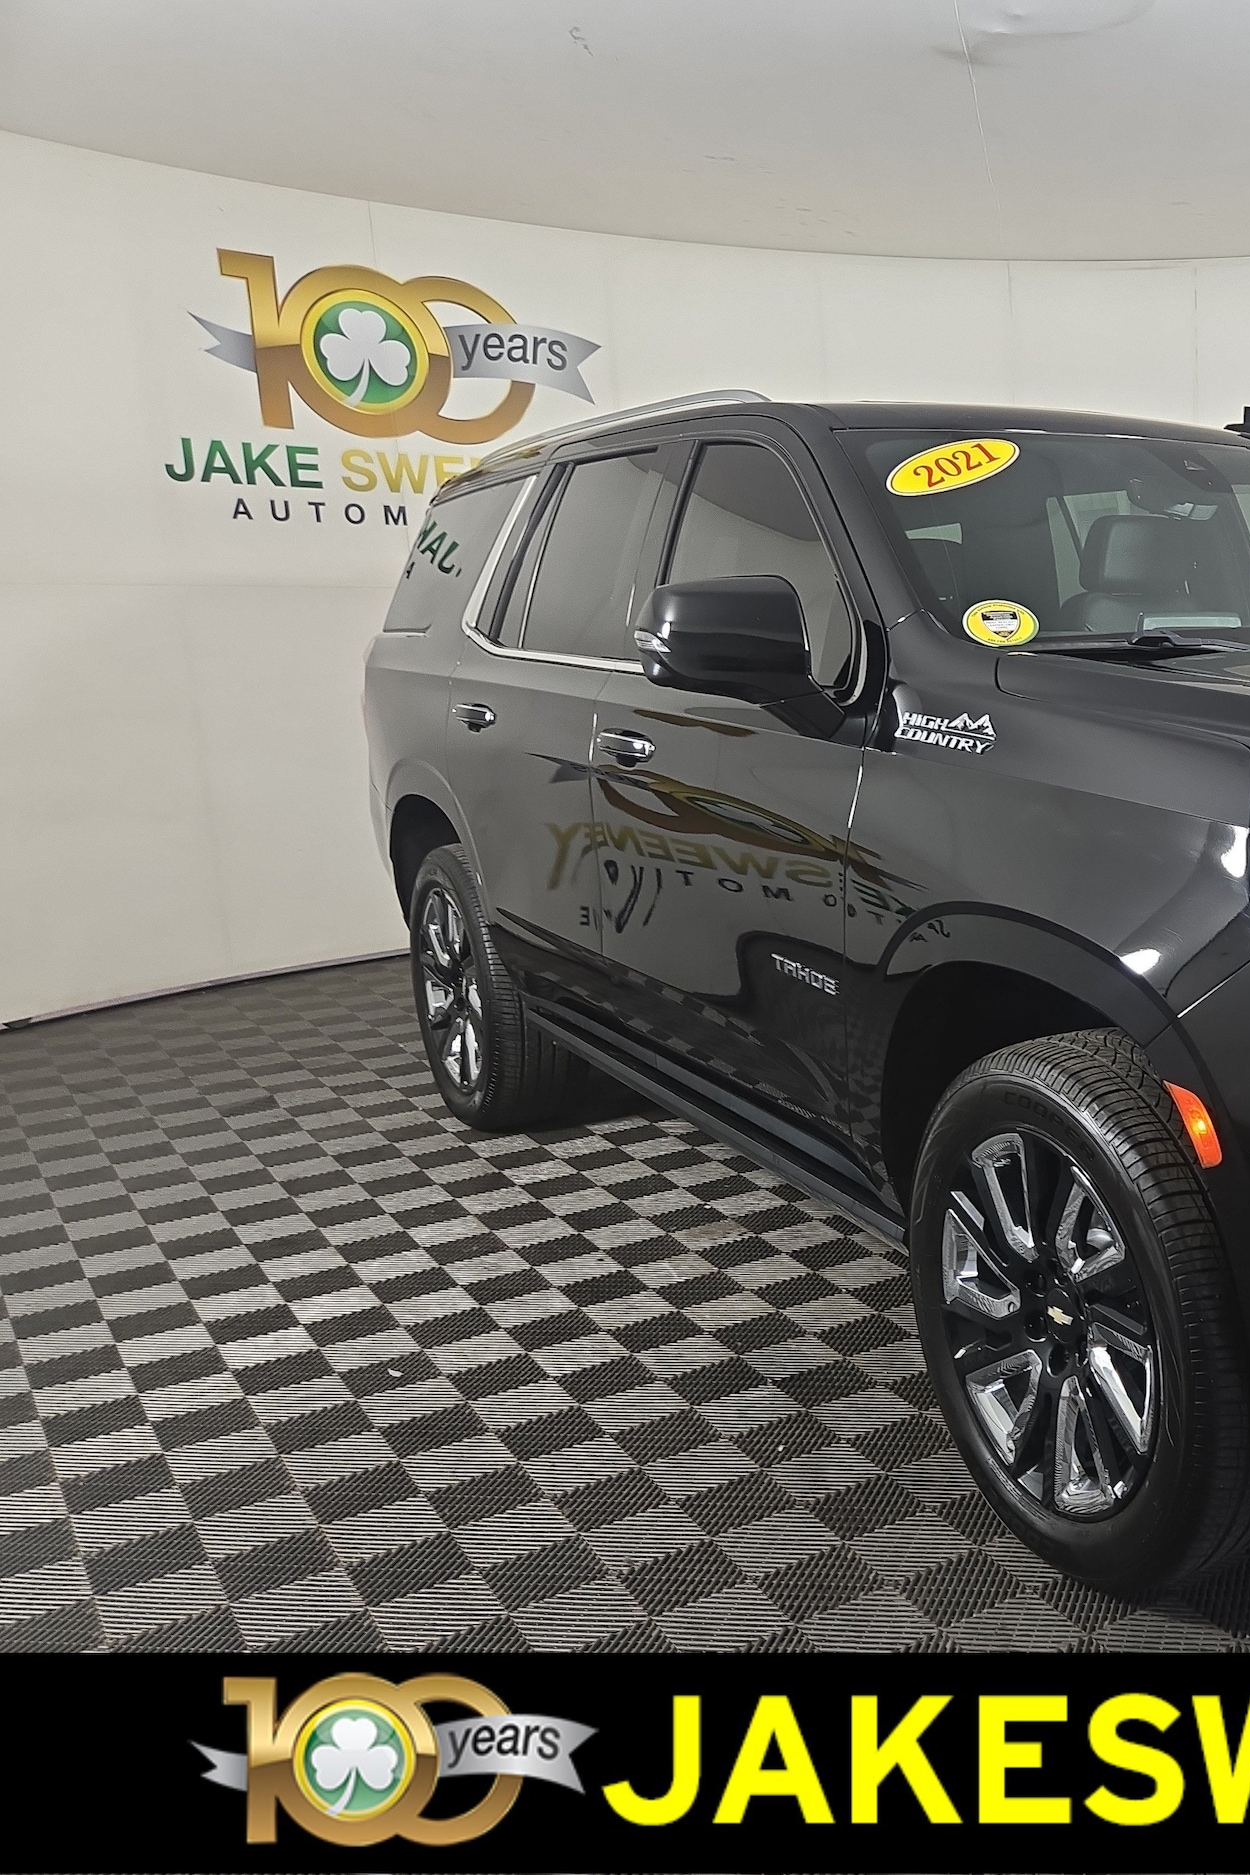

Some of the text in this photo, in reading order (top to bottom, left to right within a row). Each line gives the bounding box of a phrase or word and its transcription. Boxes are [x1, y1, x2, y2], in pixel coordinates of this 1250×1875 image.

[216, 248, 536, 445] 100
[457, 331, 569, 372] years
[164, 437, 324, 490] JAKE
[913, 443, 1001, 488] 2021
[232, 498, 408, 526] AUTOM
[894, 727, 995, 754] COUNTRY
[903, 712, 950, 731] HIGH
[771, 953, 840, 996] TAHOE
[1004, 1091, 1096, 1162] COOPER
